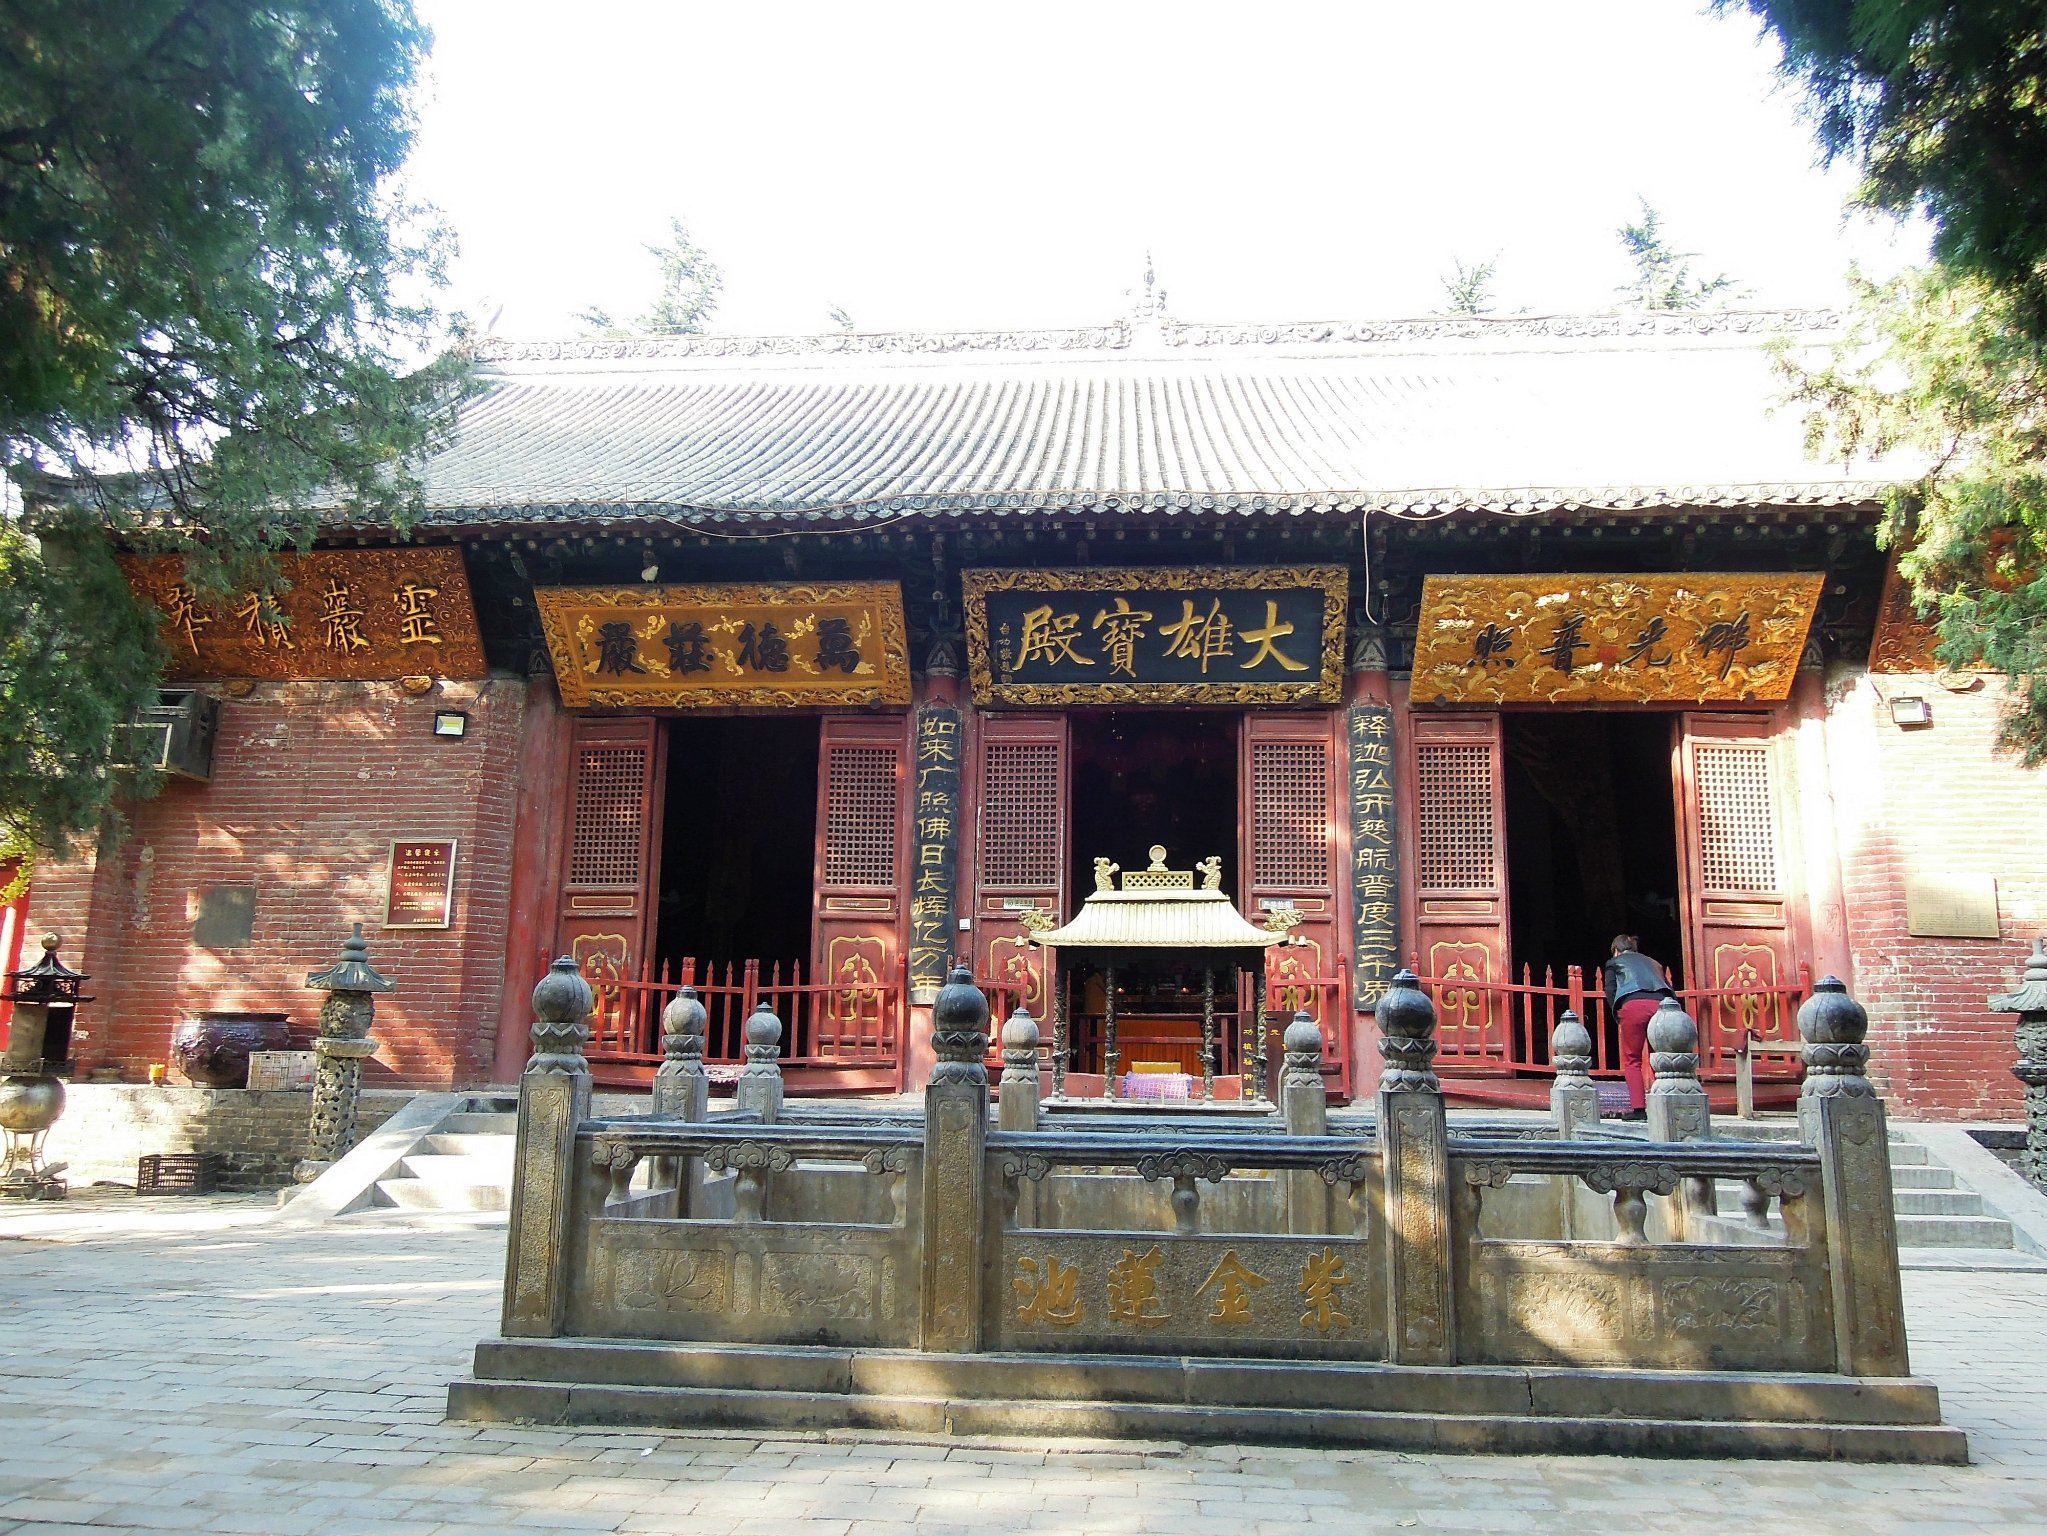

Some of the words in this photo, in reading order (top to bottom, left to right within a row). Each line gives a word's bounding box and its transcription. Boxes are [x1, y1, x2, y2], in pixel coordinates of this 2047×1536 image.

[1012, 596, 1311, 679] 大雄寶殿
[1465, 609, 1751, 681] 佛光普照
[1010, 1244, 1354, 1332] 紫金蓮池
